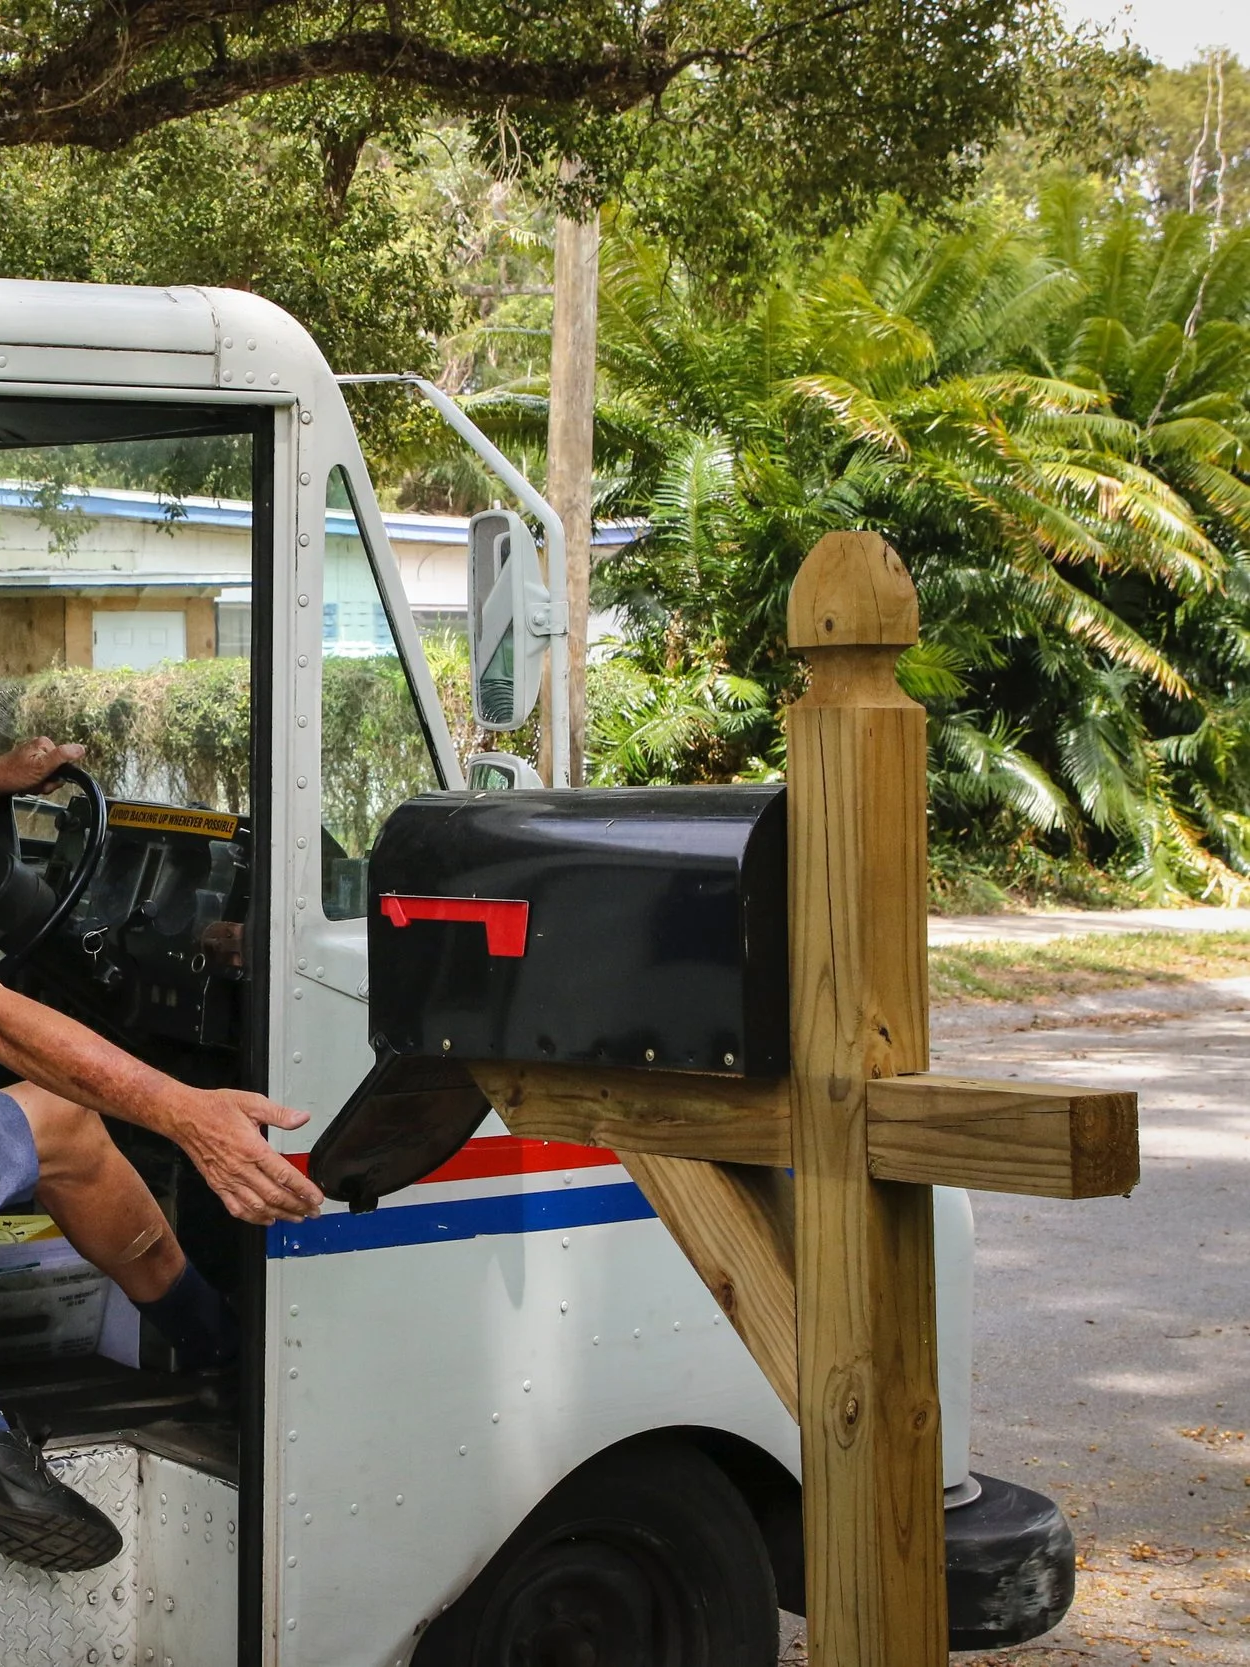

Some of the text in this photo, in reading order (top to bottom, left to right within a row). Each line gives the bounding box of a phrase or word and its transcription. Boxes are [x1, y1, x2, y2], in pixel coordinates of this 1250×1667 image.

[111, 808, 234, 833] AVOID BACKING UP WHENEVER POSSIBLE
